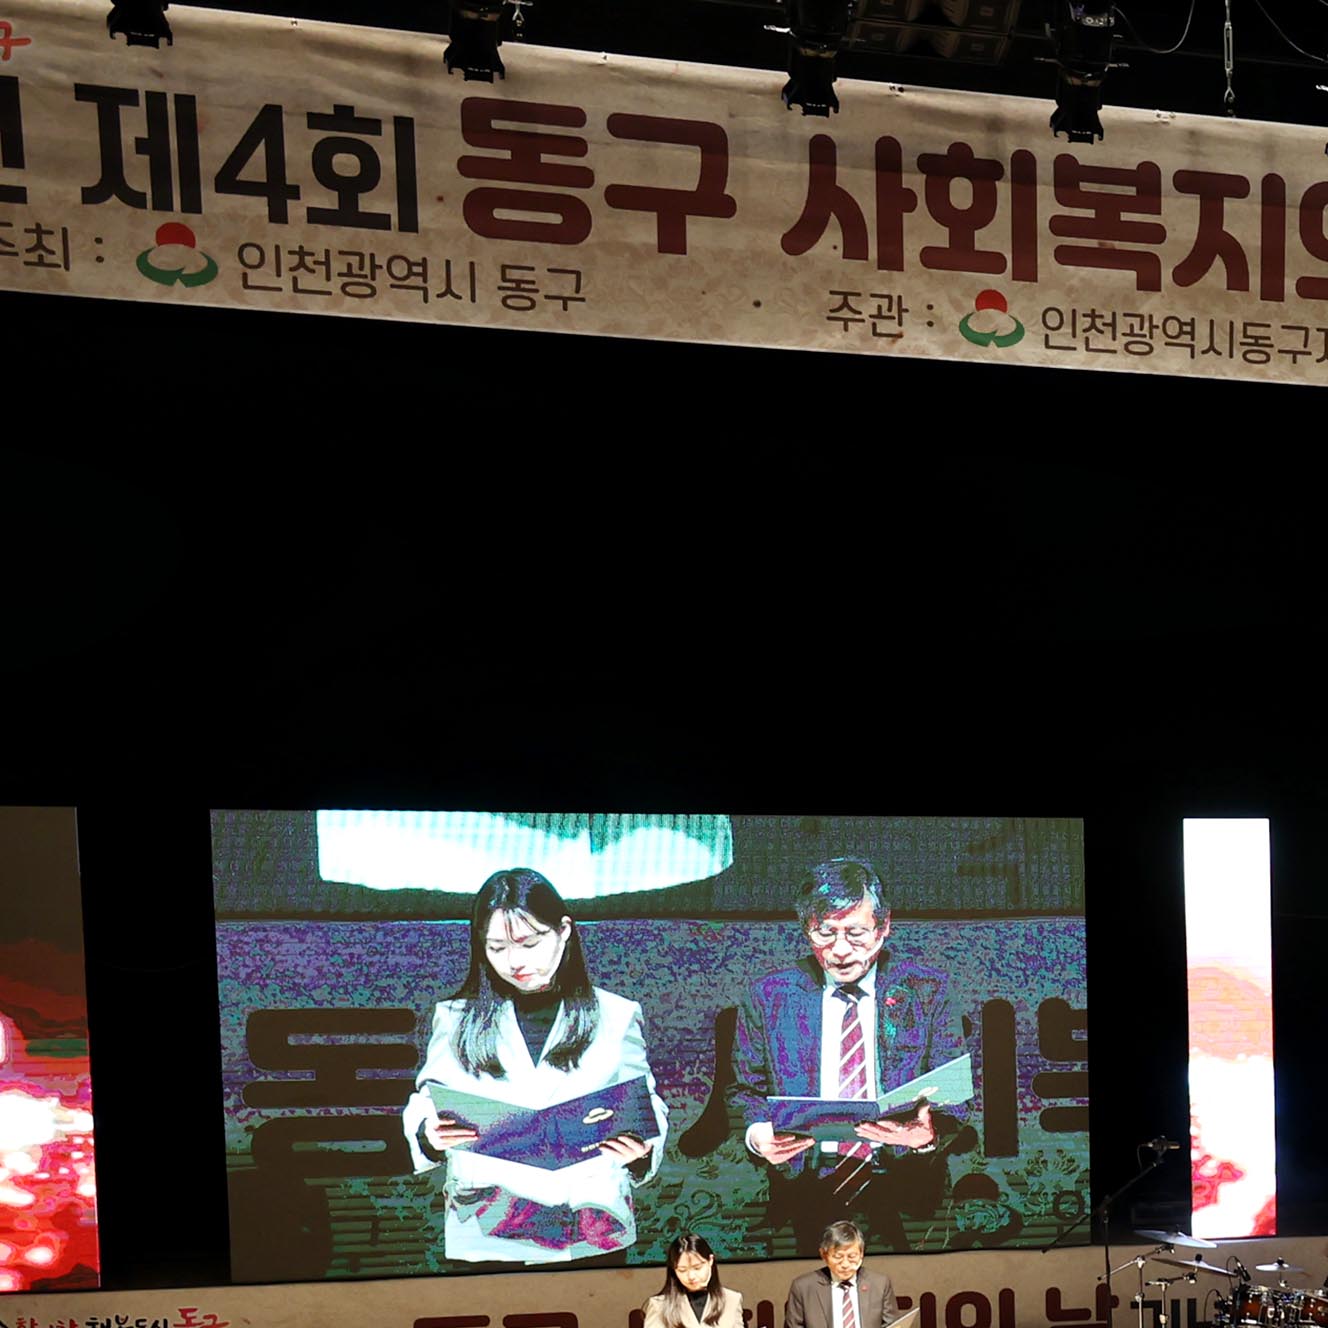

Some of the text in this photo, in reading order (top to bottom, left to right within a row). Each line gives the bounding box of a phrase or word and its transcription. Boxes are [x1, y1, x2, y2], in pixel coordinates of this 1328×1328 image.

[74, 83, 419, 234] 제4회
[456, 97, 738, 255] 동구
[237, 241, 477, 304] 인천광역시
[497, 265, 587, 312] 동구
[826, 290, 905, 339] 주관
